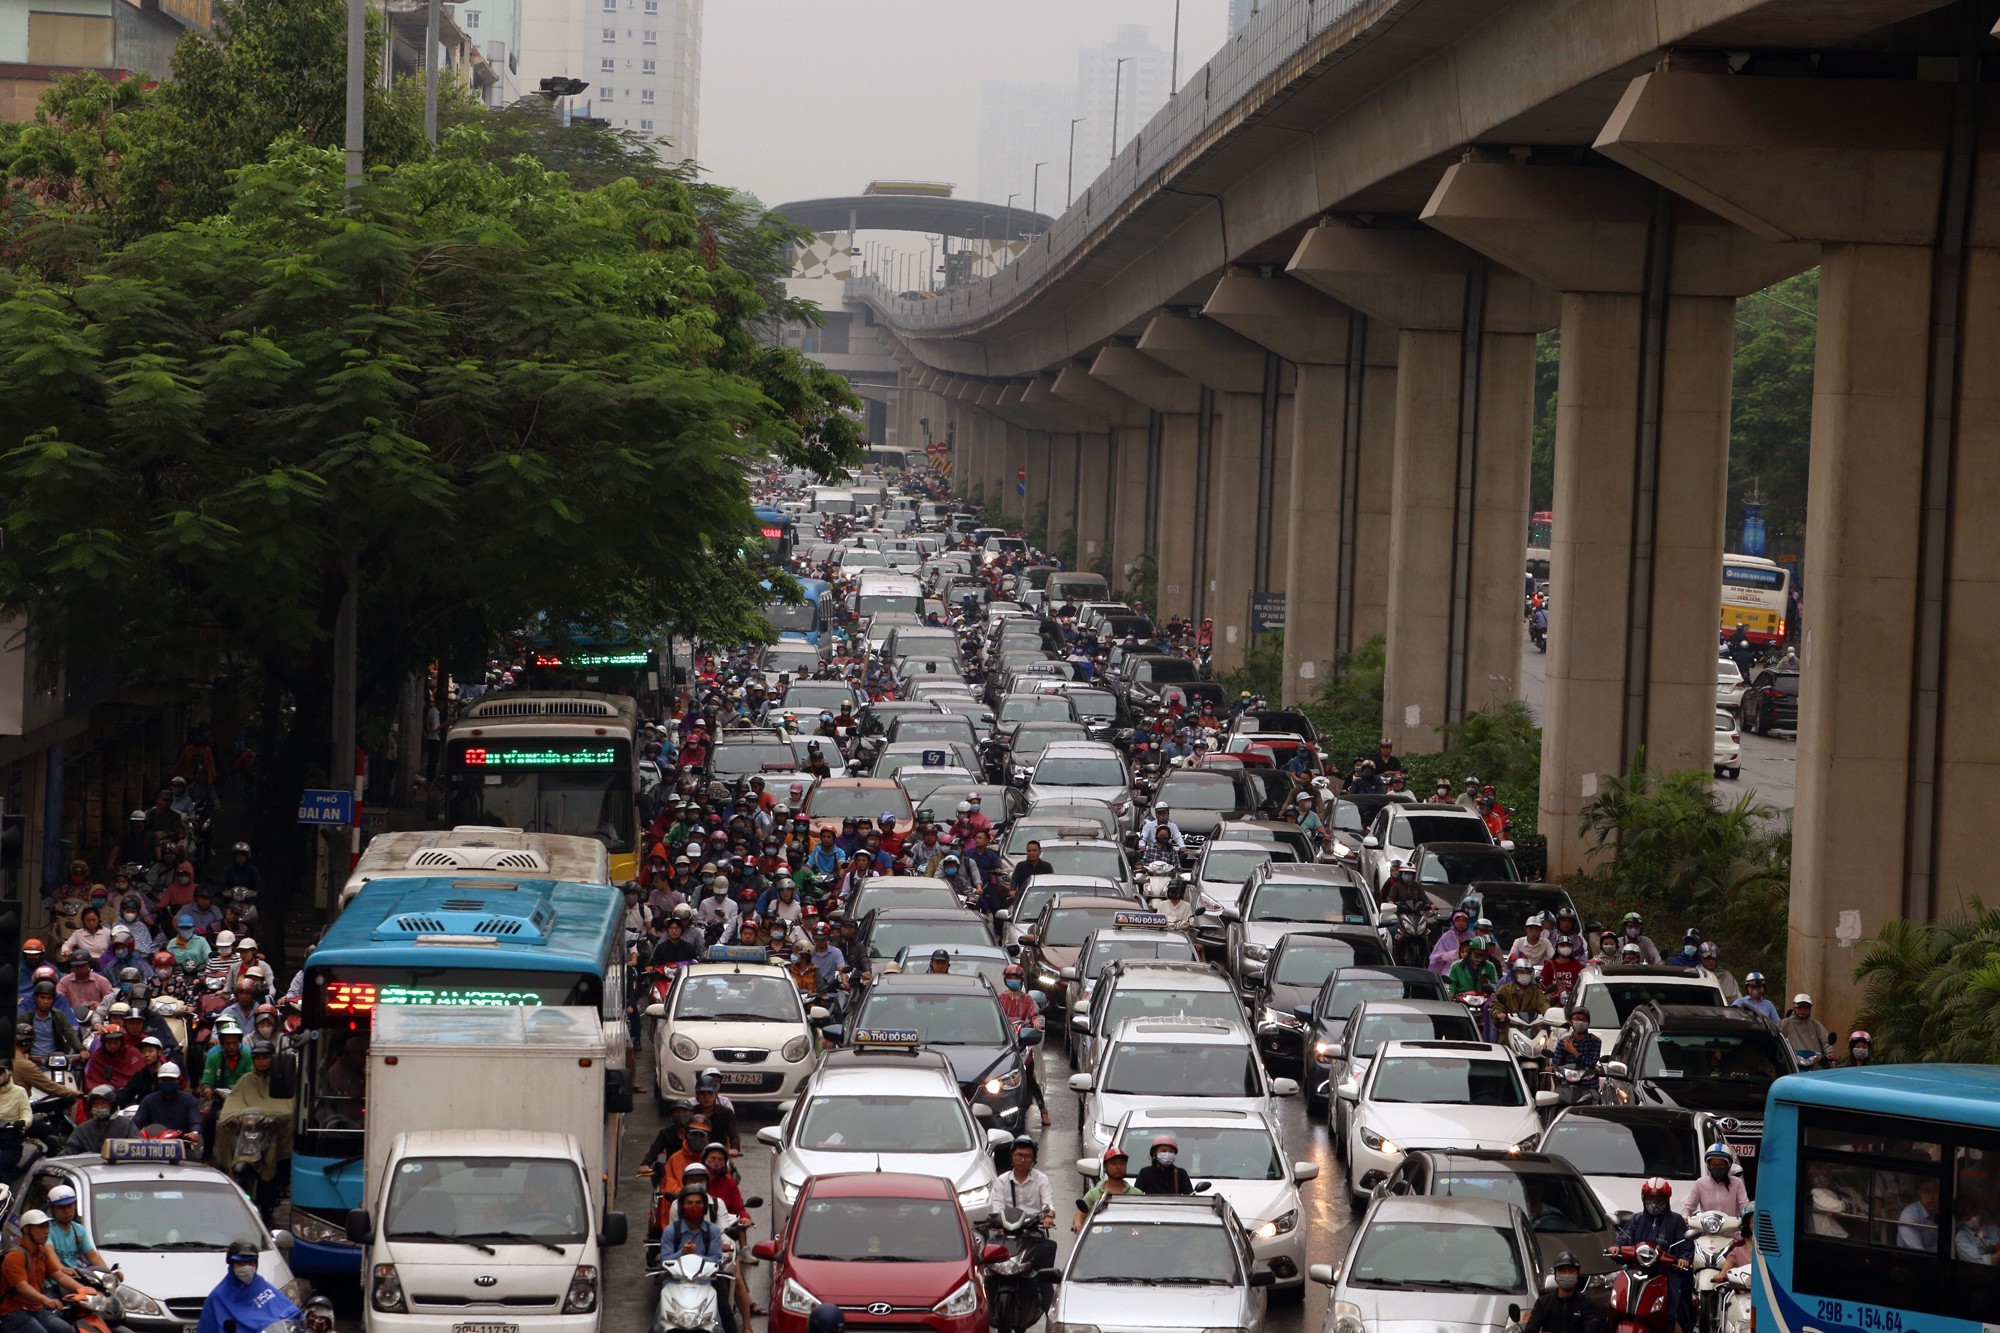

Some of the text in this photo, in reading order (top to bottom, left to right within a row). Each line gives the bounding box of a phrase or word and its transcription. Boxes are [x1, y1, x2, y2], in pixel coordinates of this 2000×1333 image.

[316, 794, 338, 804] PHỐ
[322, 808, 340, 820] AN
[871, 1031, 917, 1041] THỦ ĐÔ SAO
[721, 1073, 762, 1083] 9A-472.12
[130, 1143, 176, 1157] SAO THỦ ĐÔ
[1817, 1299, 1843, 1322] 29B
[1857, 1307, 1903, 1332] 154.64
